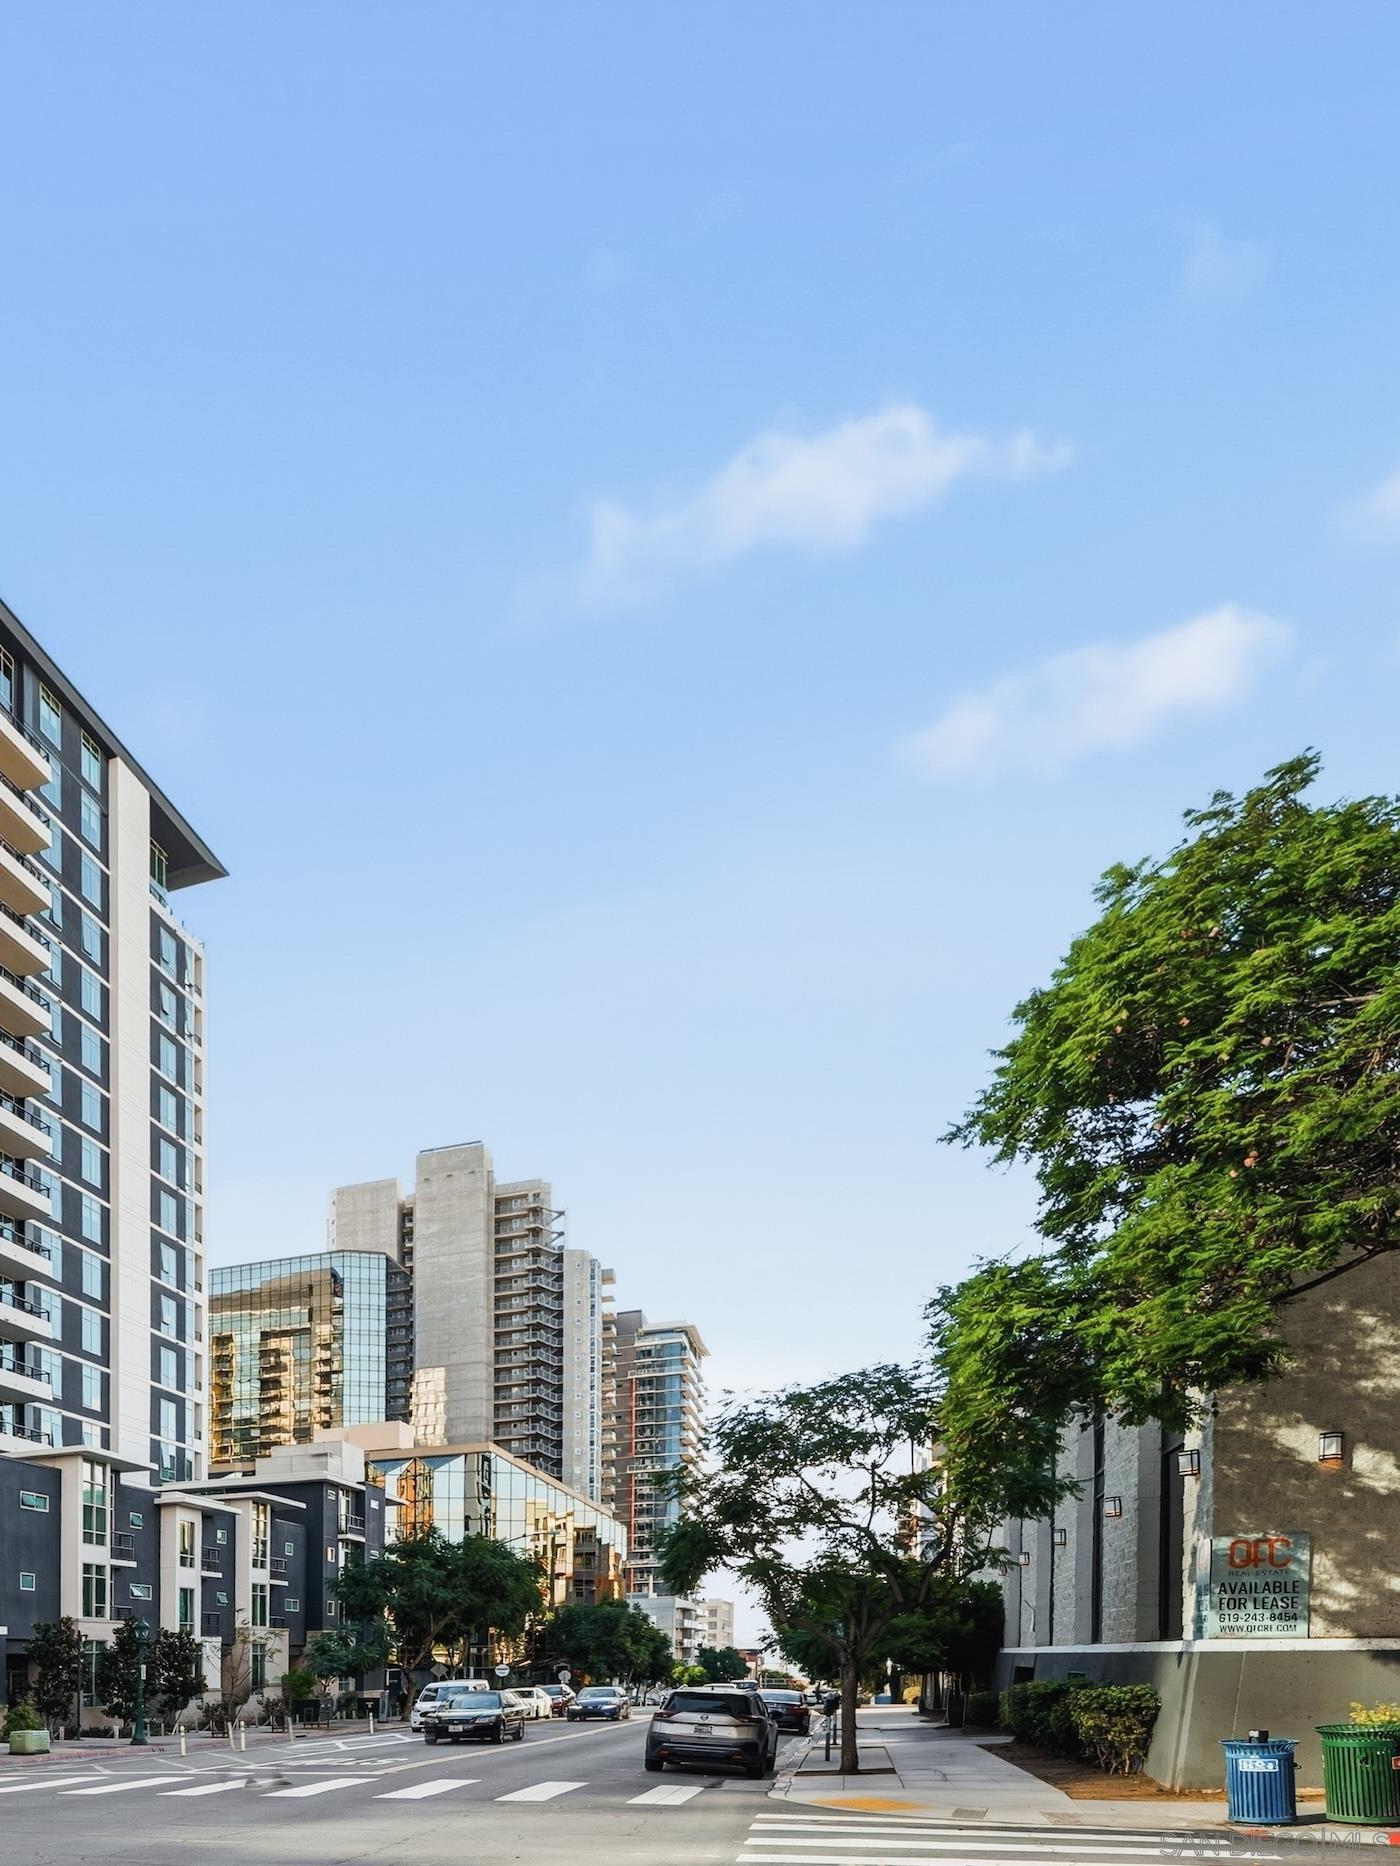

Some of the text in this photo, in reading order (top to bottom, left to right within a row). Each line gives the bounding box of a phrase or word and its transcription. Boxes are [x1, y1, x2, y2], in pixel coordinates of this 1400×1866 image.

[1218, 1580, 1301, 1595] AVAILABLE
[1219, 1596, 1300, 1611] FOR LEASE
[1219, 1612, 1298, 1623] 619-243-8454
